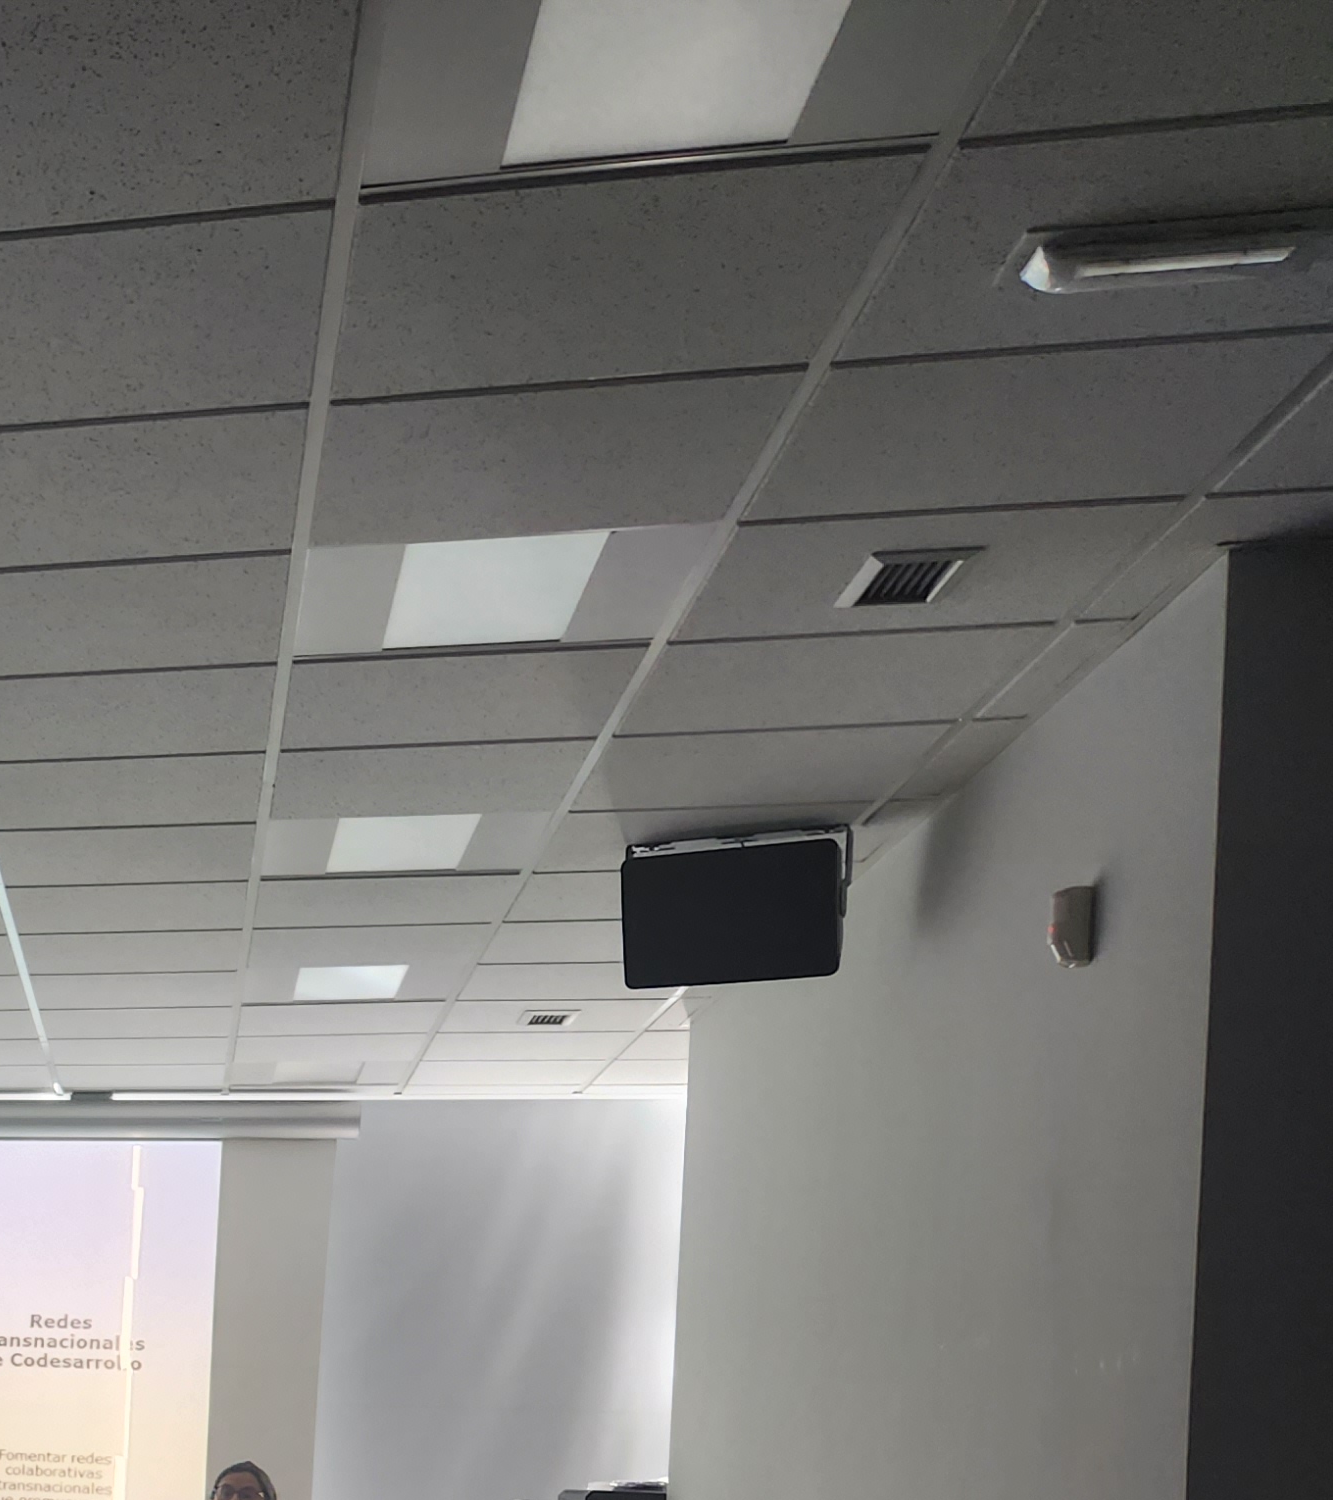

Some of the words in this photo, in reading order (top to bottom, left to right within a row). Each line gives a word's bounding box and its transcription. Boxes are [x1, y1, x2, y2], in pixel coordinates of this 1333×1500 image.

[30, 1314, 92, 1329] Redes
[11, 1353, 142, 1371] Codesarrolo
[71, 1451, 113, 1466] redes
[5, 1464, 103, 1480] colaborativas
